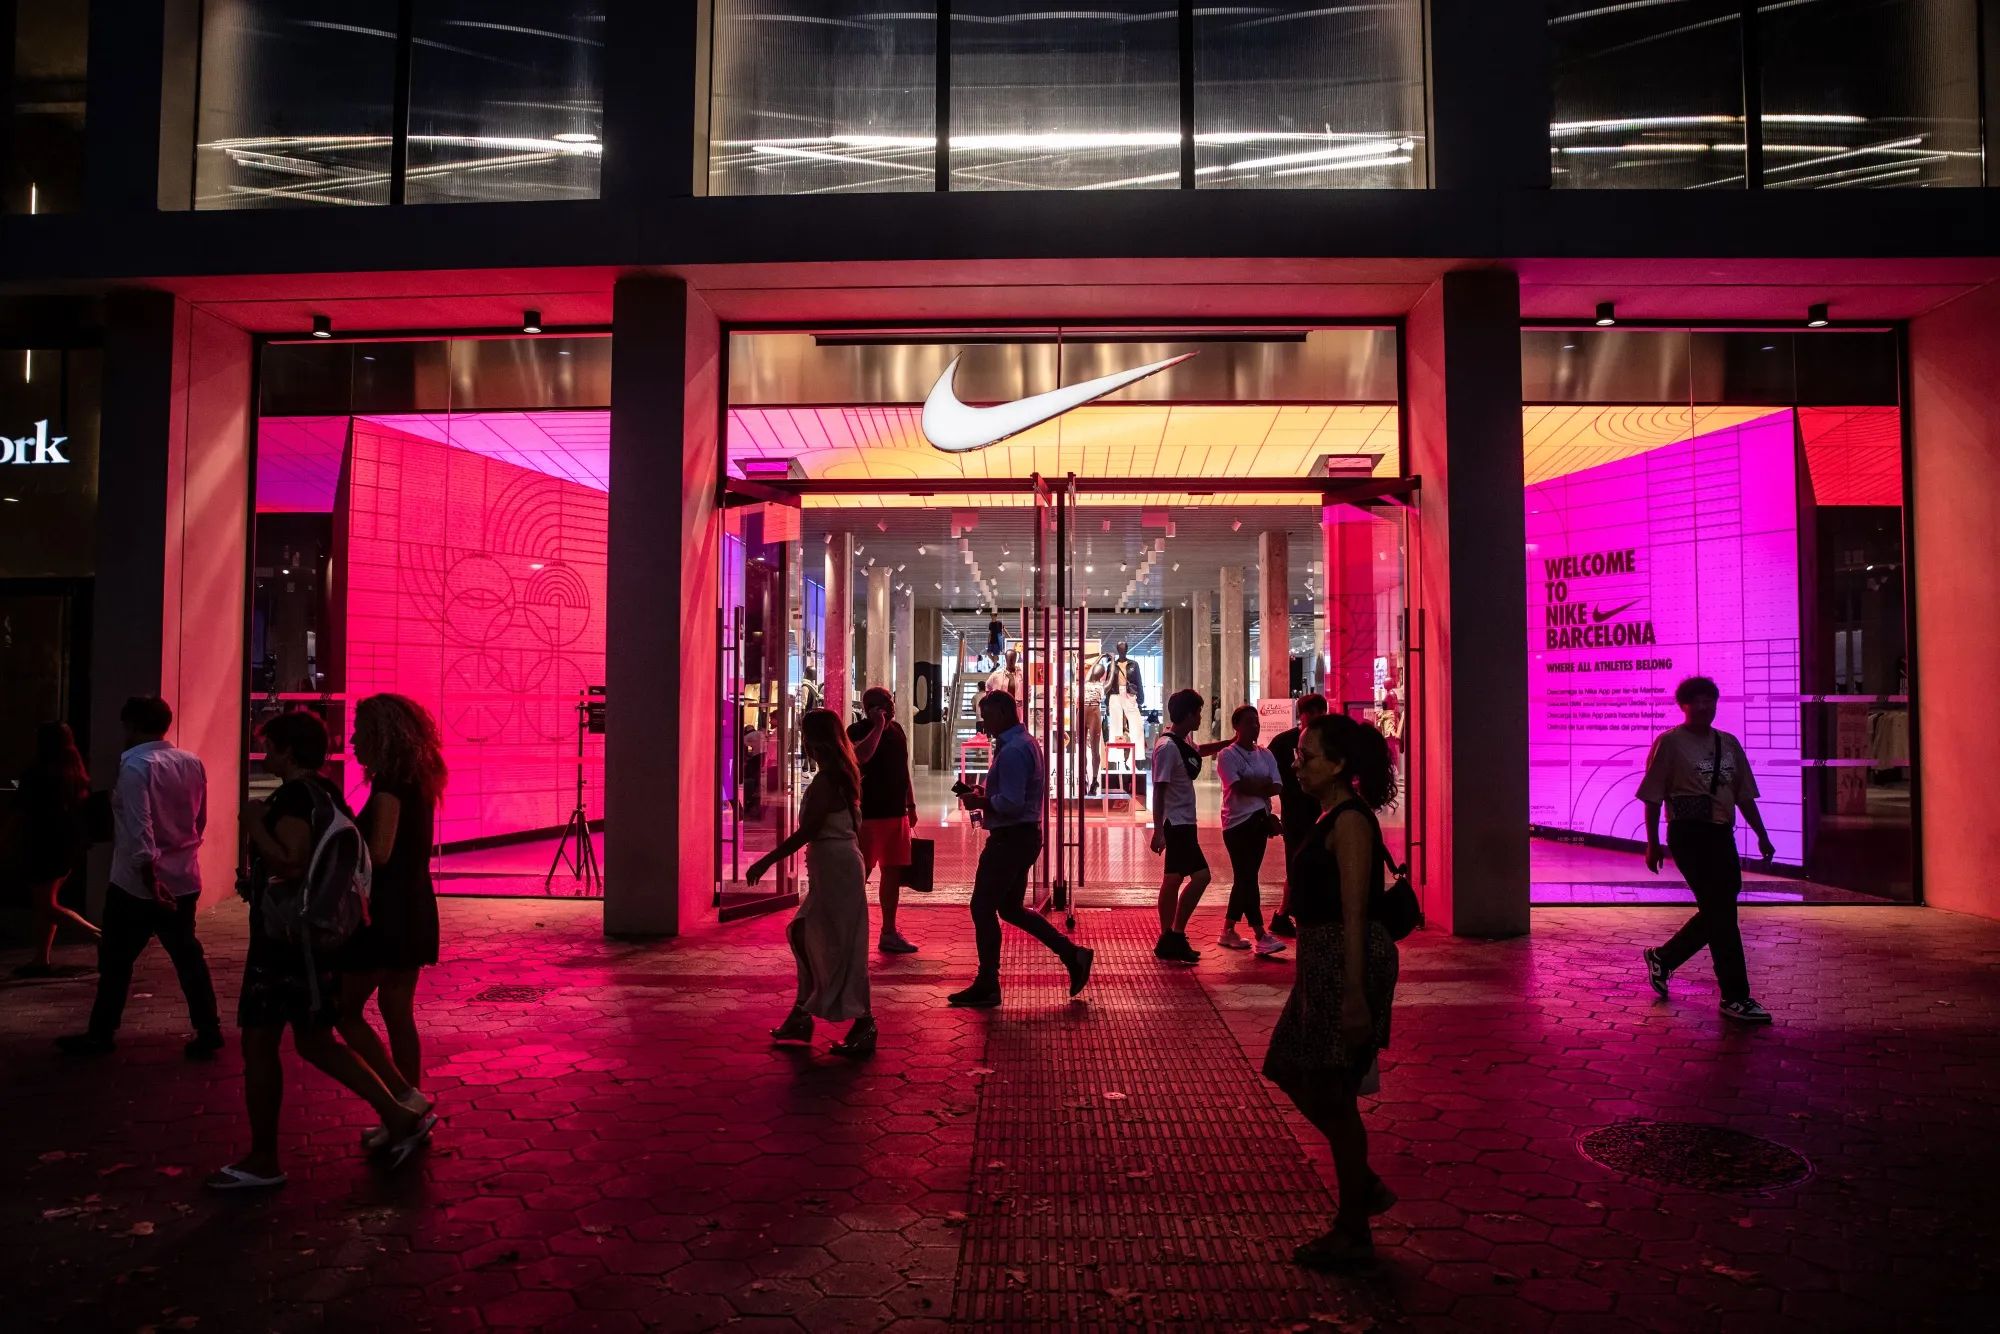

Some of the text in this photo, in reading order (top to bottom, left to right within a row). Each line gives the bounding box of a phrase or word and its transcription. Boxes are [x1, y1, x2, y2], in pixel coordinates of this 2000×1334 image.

[1544, 550, 1635, 580] WELCOME
[1545, 581, 1568, 603] TO
[1546, 603, 1588, 626] NIKE
[1546, 621, 1656, 649] BARCELONA
[1546, 658, 1673, 673] WHERE ALL ATHLETES BELONG
[1598, 688, 1611, 696] App
[1592, 711, 1604, 719] App
